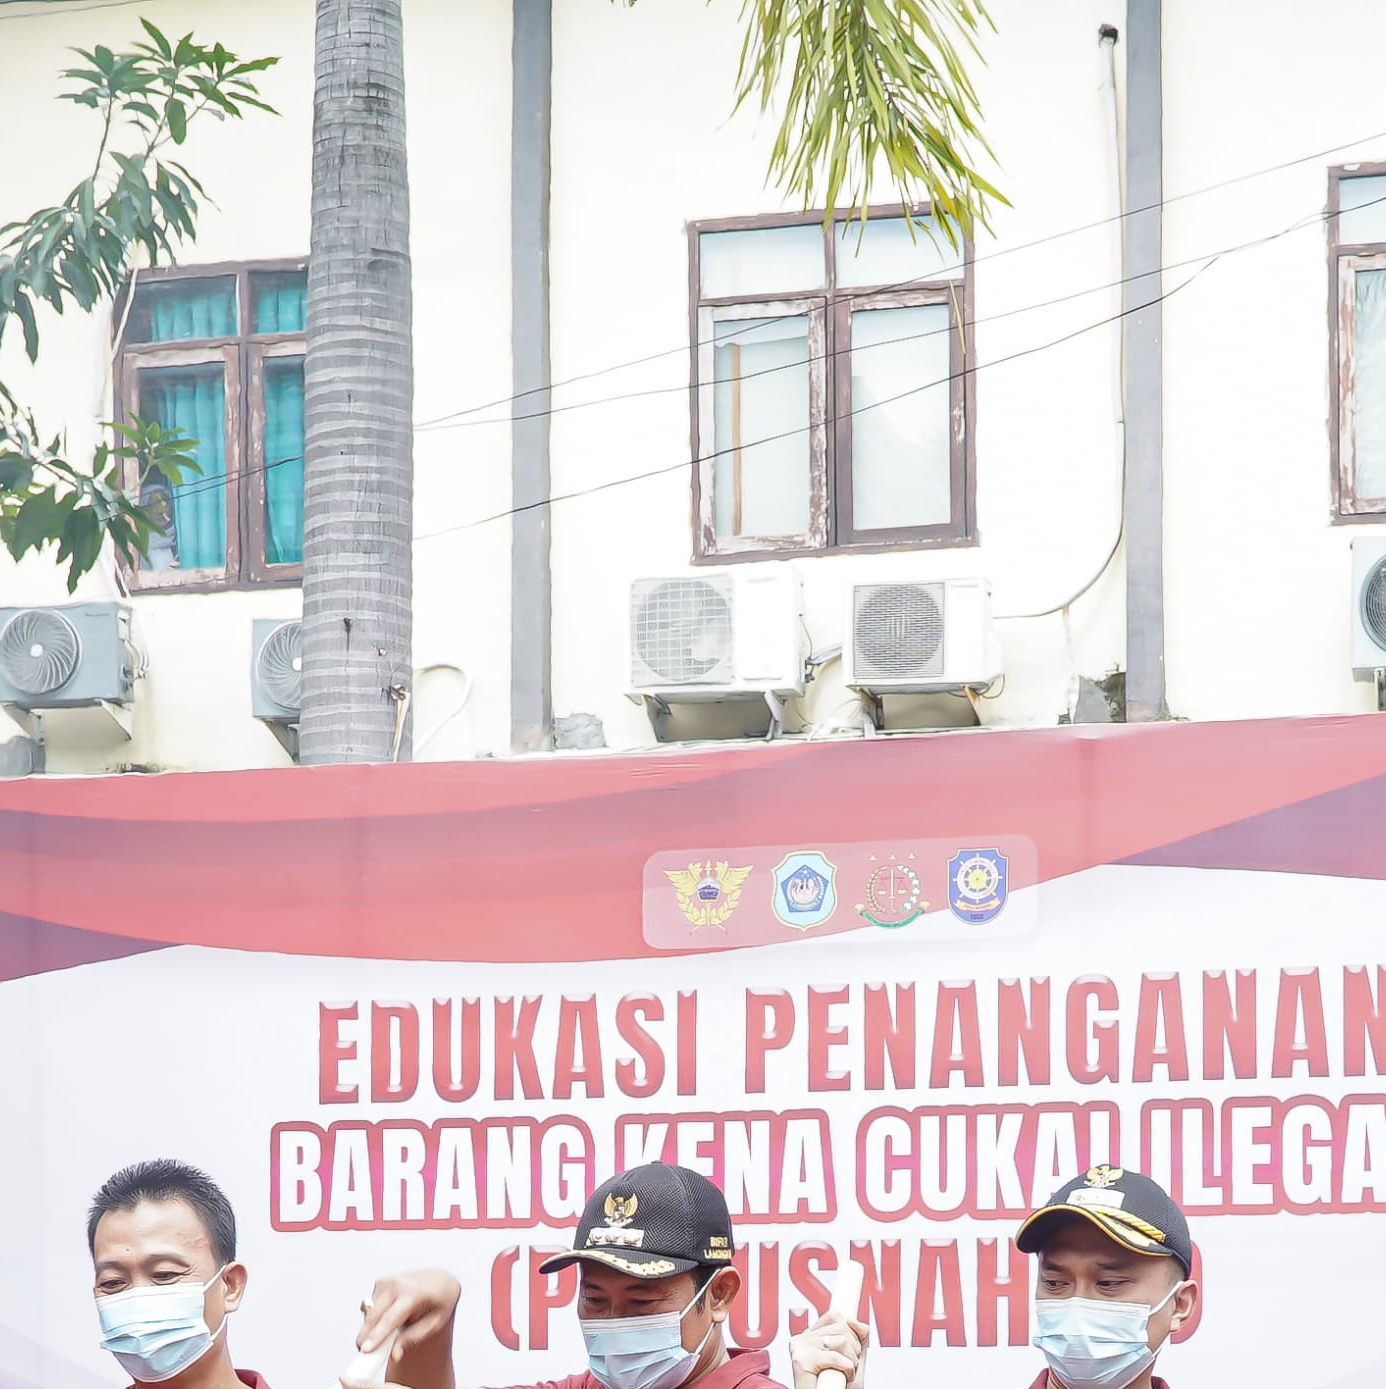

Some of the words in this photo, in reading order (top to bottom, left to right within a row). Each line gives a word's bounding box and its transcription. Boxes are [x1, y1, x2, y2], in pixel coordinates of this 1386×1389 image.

[318, 987, 698, 1105] EDUKASI
[274, 1118, 591, 1227] BARANG
[861, 1106, 1115, 1214] CUKAI
